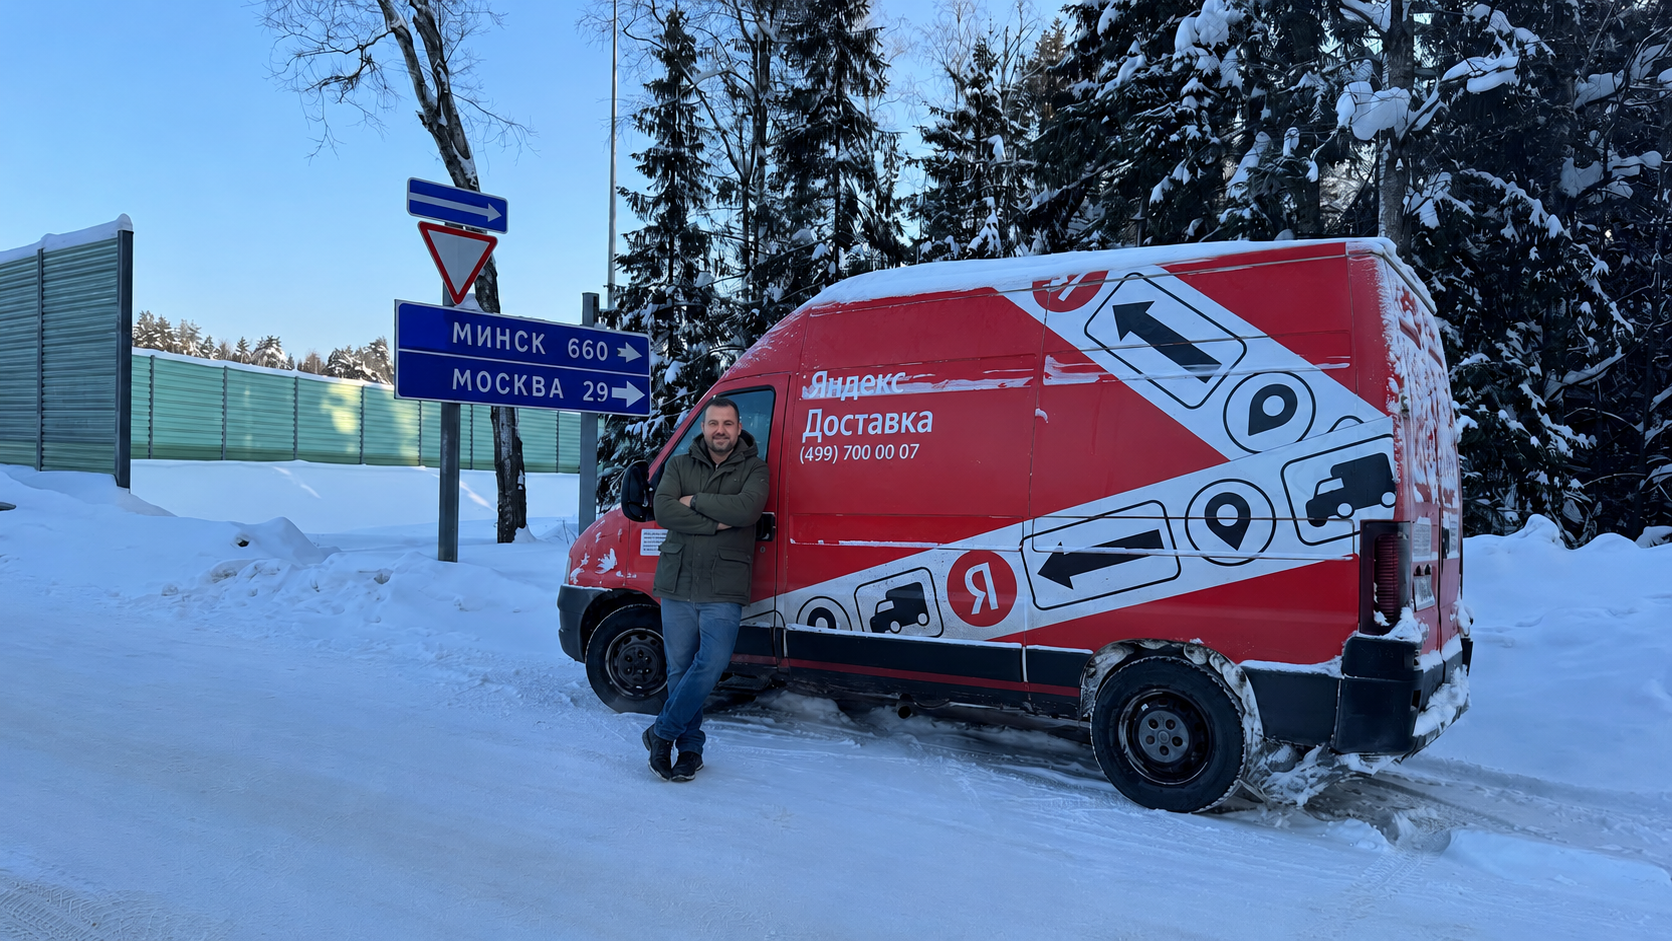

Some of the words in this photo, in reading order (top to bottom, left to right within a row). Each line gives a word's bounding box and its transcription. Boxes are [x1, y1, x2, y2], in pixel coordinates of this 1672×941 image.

[453, 322, 546, 354] МИНСК
[568, 338, 608, 361] 660
[453, 369, 563, 399] МОСКВА
[583, 381, 608, 402] 29
[810, 371, 906, 401] Яндекс
[802, 408, 933, 443] Доставка
[800, 445, 838, 464] (499)
[843, 445, 871, 460] 700
[875, 444, 894, 460] 00
[899, 443, 920, 459] 07
[965, 562, 999, 615] Я
